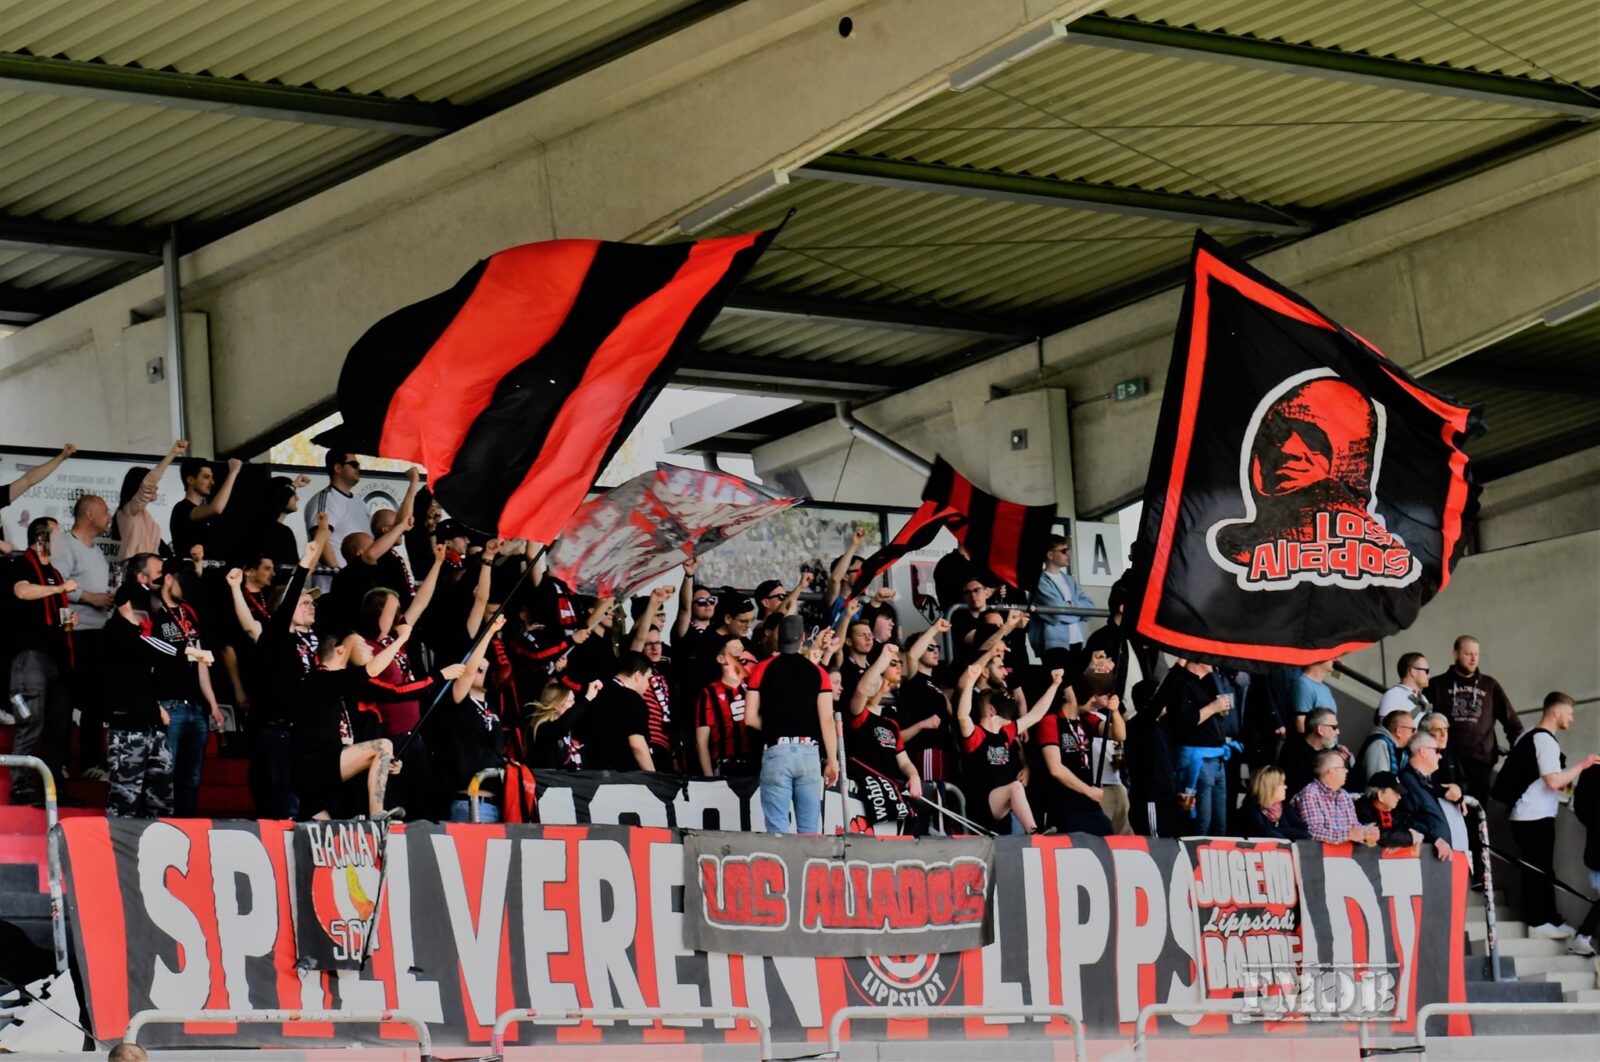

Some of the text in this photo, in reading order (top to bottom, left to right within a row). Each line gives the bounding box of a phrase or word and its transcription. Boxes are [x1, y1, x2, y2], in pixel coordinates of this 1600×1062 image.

[1092, 533, 1111, 576] A
[699, 854, 987, 932] LOS ALIADOS
[1196, 848, 1298, 905] JUGEND
[1203, 906, 1296, 937] Lippstadt
[861, 971, 946, 1008] LIPPSTADT
